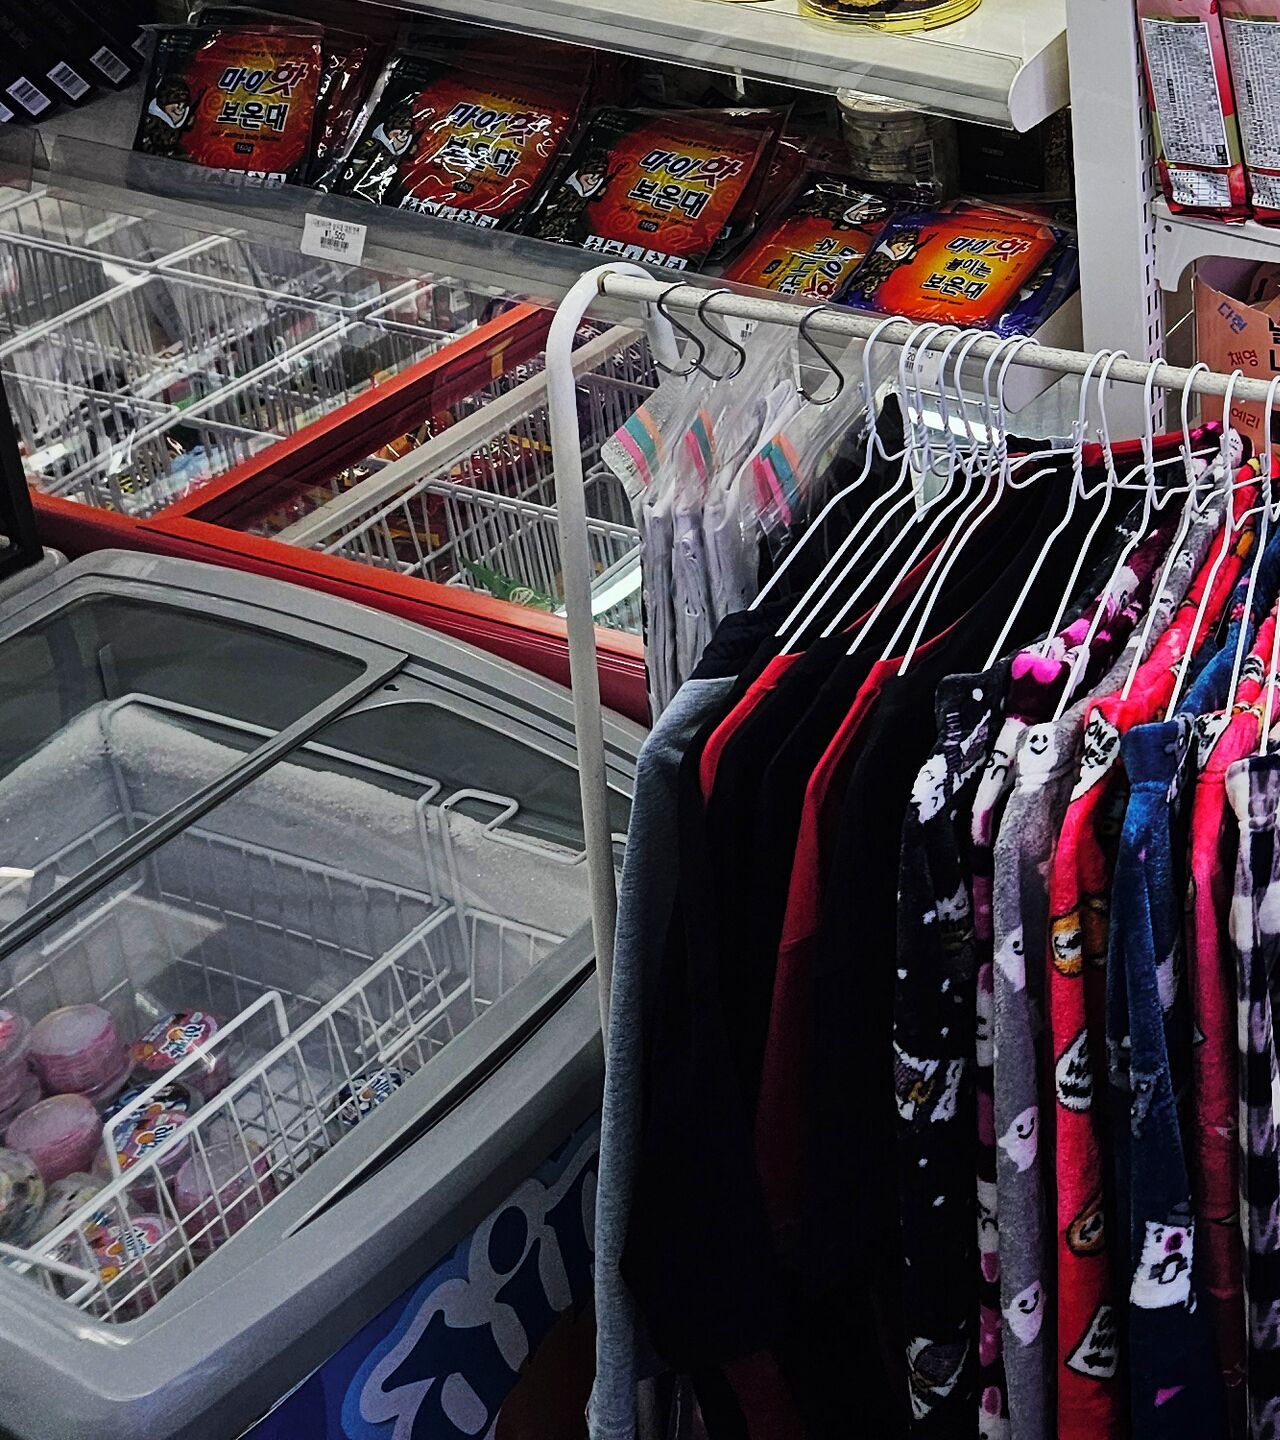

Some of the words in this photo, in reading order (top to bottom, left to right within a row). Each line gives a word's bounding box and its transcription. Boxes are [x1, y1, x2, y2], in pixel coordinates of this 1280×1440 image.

[219, 60, 309, 97] 마이핫
[216, 100, 290, 133] 보온대
[638, 148, 742, 189] 마이핫
[628, 177, 709, 220] 보온대
[945, 235, 1028, 263] 마이핫
[945, 257, 992, 279] 붙이는
[920, 272, 988, 301] 보온대
[1217, 302, 1247, 334] 다현
